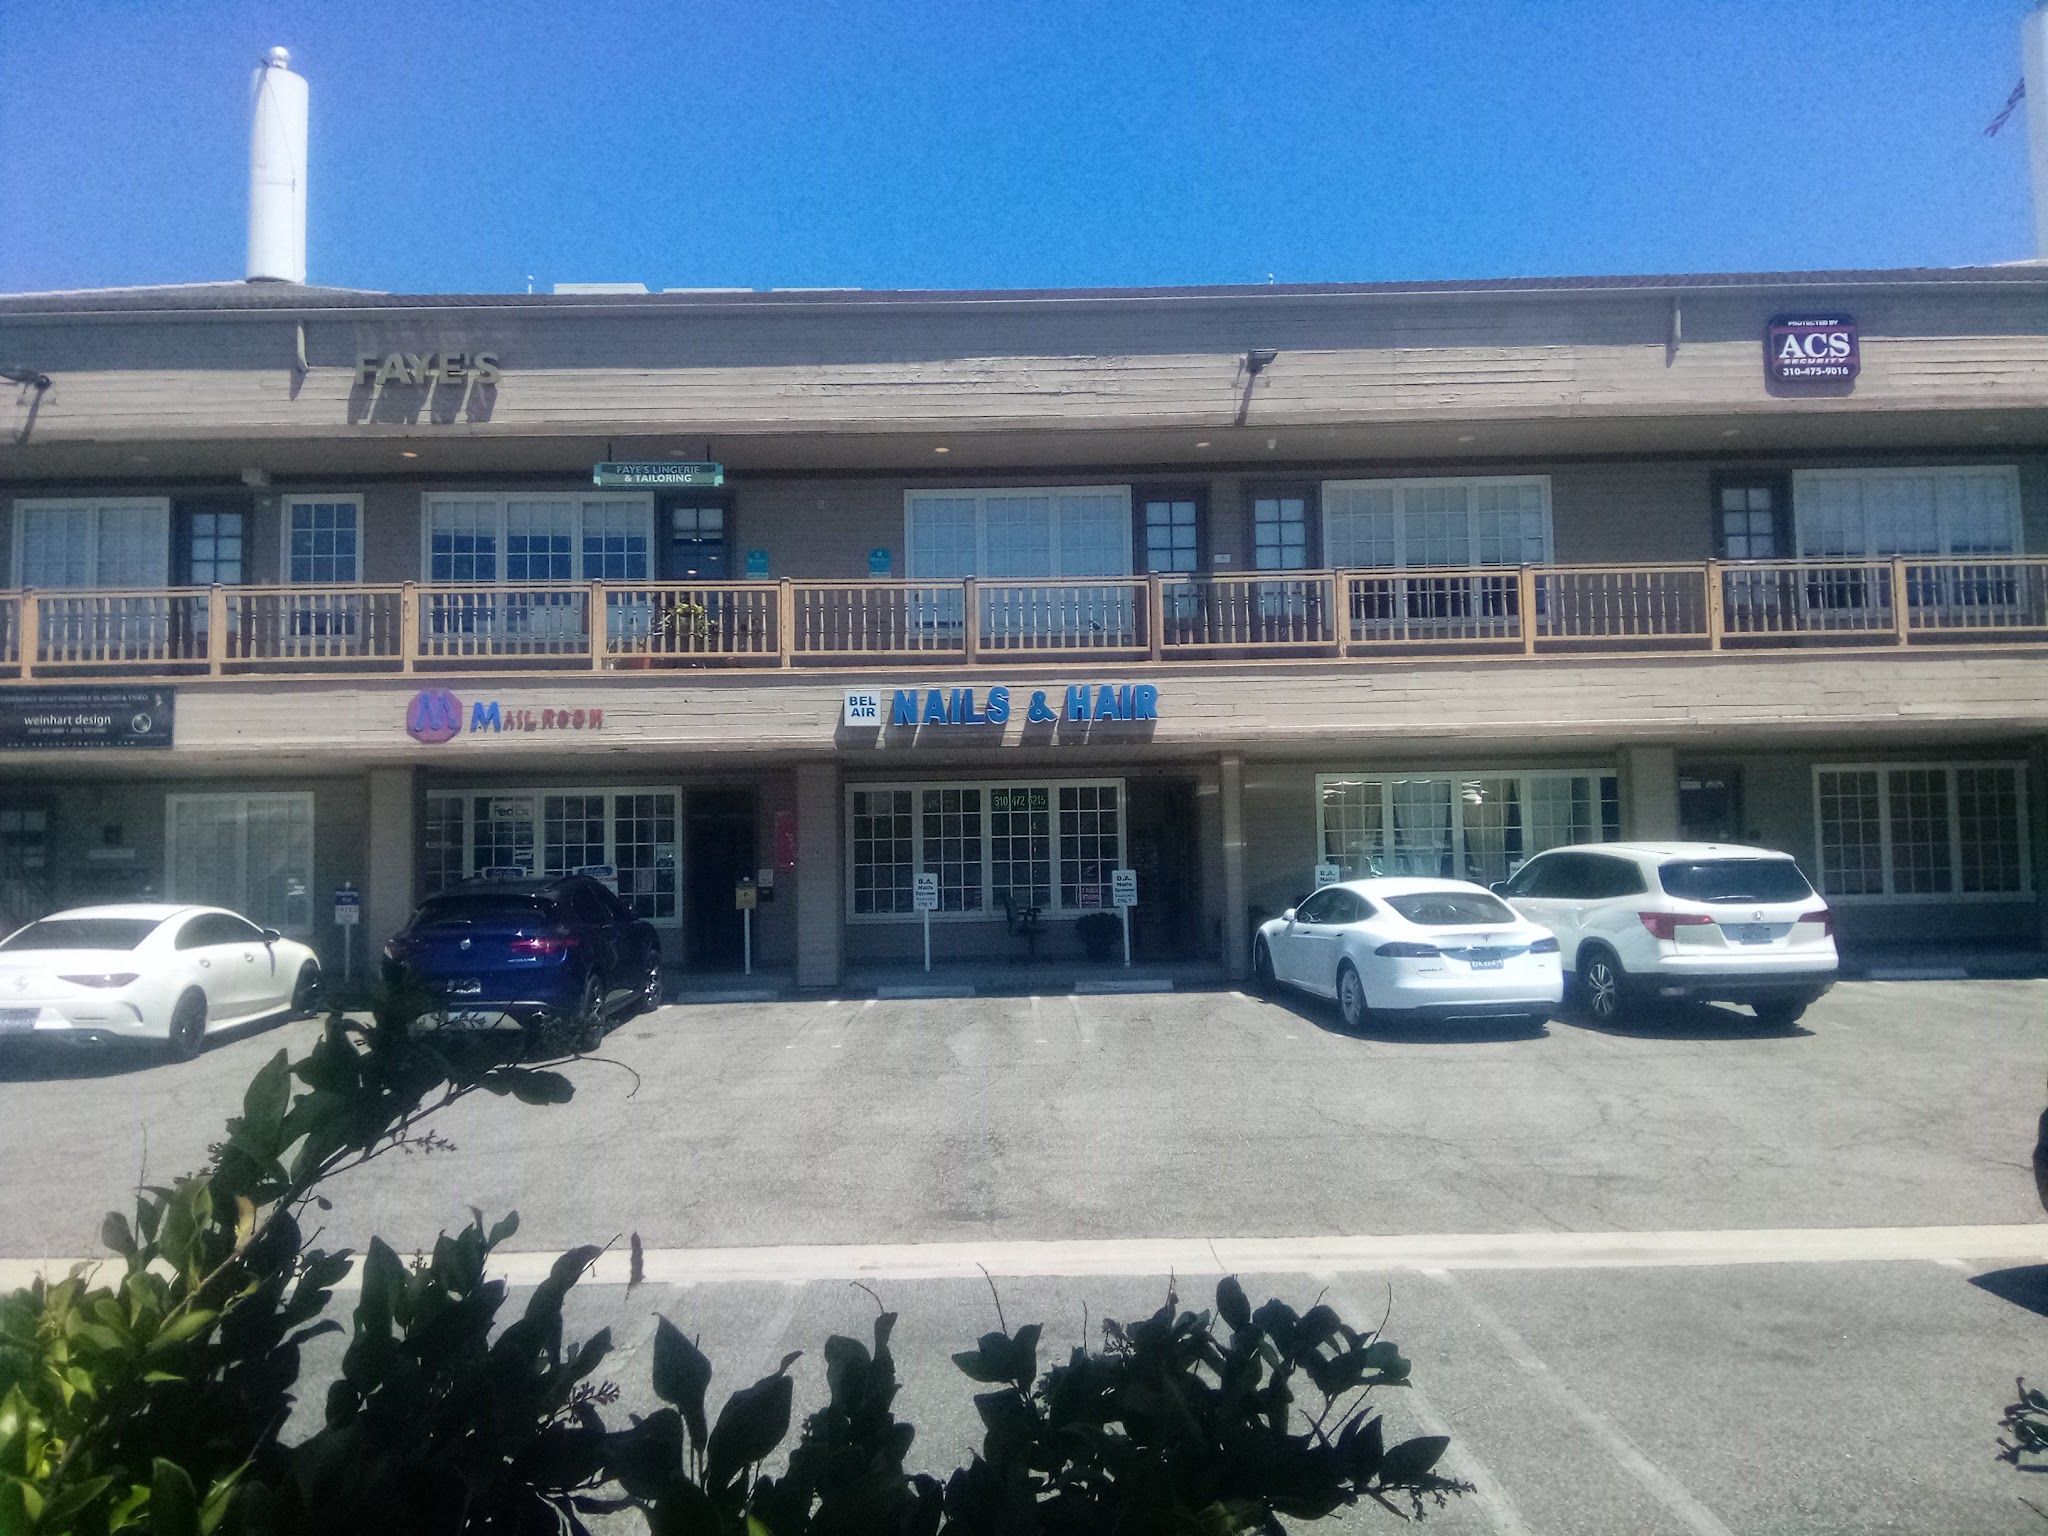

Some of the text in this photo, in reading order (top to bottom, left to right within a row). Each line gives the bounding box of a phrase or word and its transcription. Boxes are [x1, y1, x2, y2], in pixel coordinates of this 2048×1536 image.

[1779, 332, 1851, 358] ACS
[354, 351, 501, 385] FAYE'S
[1783, 367, 1849, 376] 310-475-9016
[652, 465, 700, 474] LINGERIE
[624, 474, 692, 483] & TAILORING
[849, 696, 877, 706] BEL
[893, 683, 1159, 726] NAILS & HAIR
[850, 707, 876, 718] AIR
[24, 714, 111, 726] weinhart design
[994, 795, 1008, 806] 310
